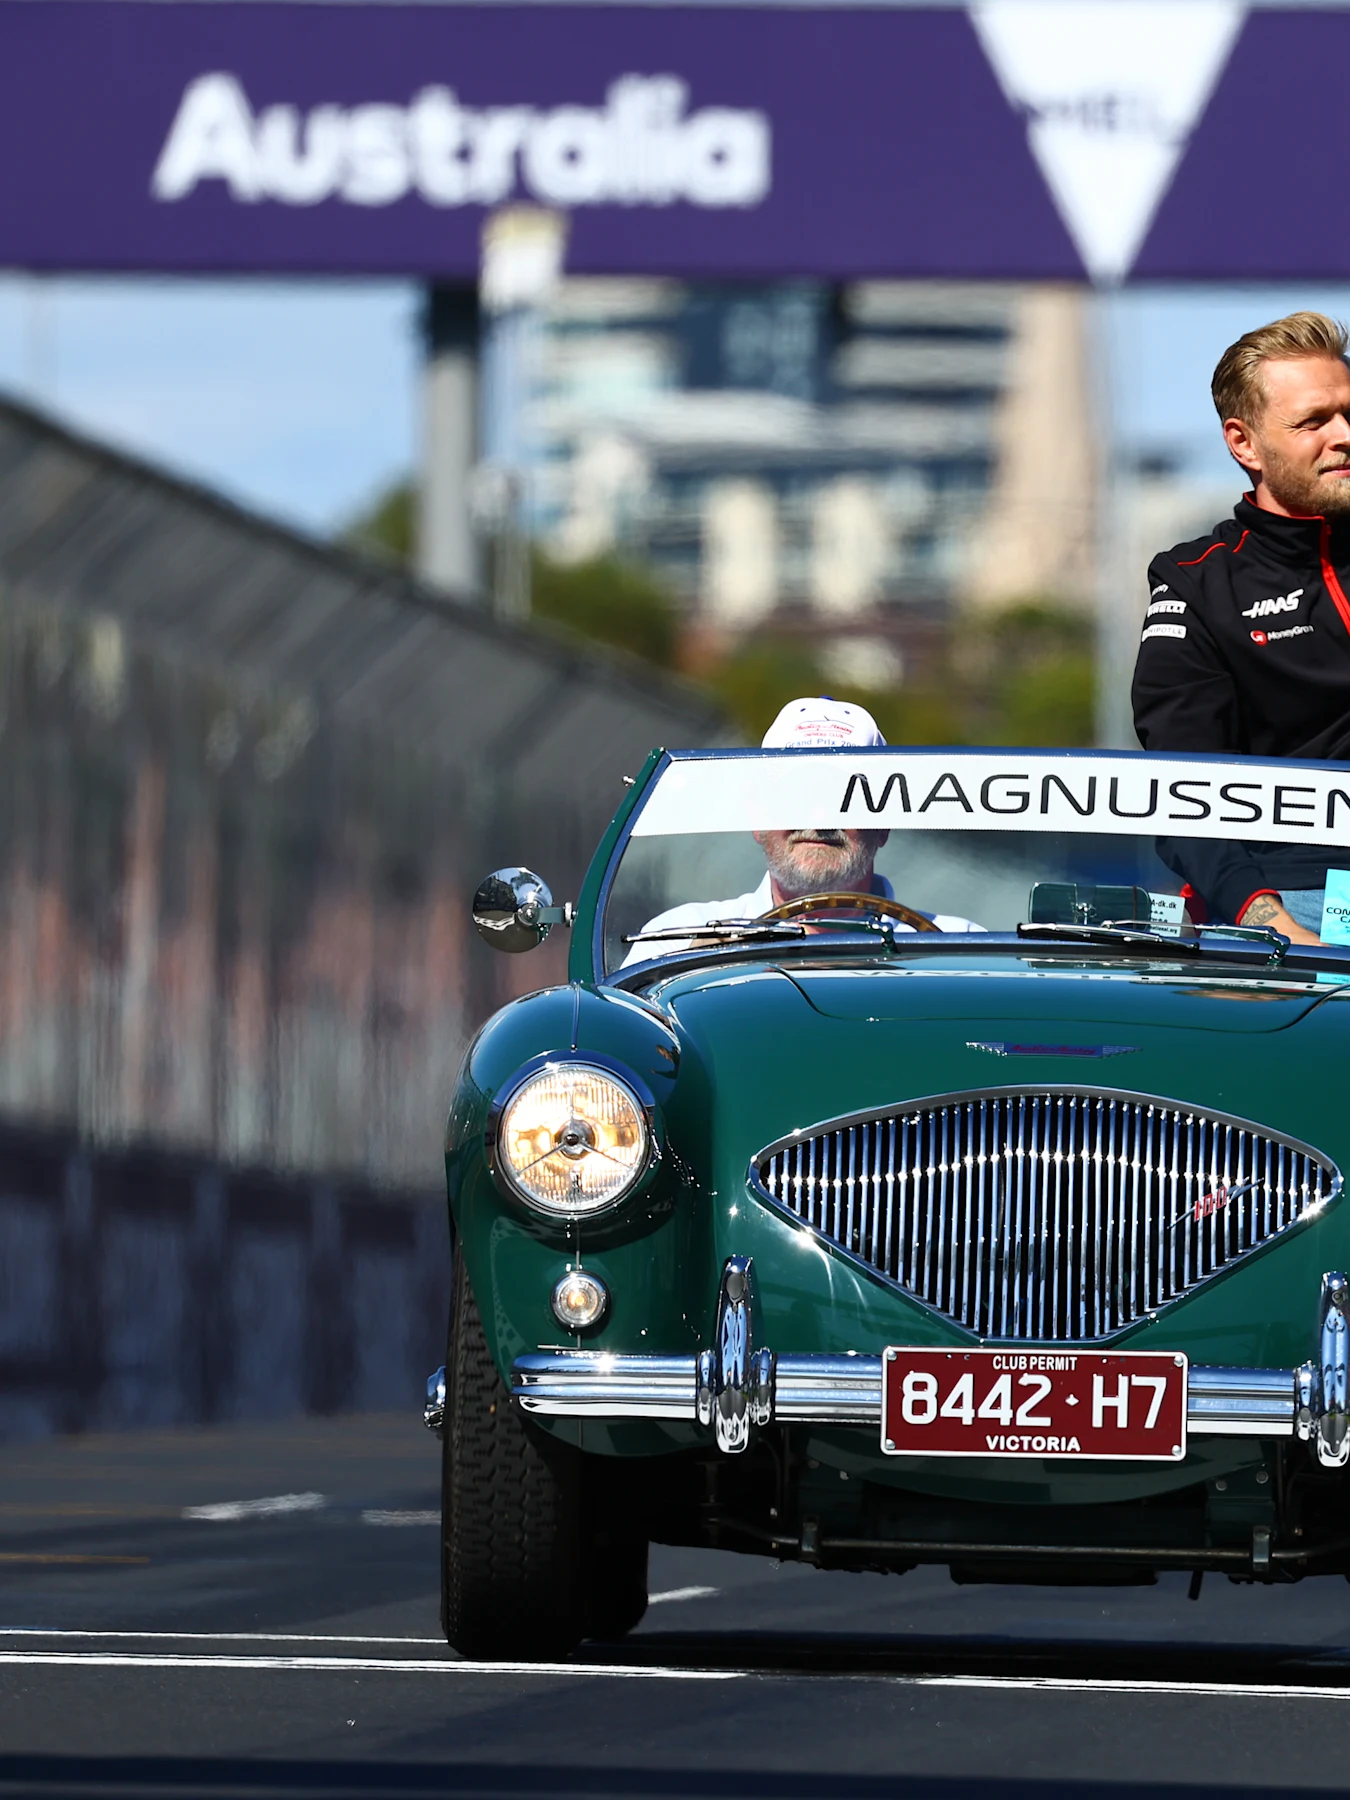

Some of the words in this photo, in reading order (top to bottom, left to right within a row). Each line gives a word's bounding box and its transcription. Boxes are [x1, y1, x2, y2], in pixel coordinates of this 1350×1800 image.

[154, 73, 769, 207] Australia
[1242, 588, 1304, 618] HAAS
[1193, 1185, 1227, 1222] 100
[992, 1356, 1027, 1370] CLUB
[1029, 1357, 1078, 1371] PERMIT
[901, 1371, 1053, 1427] 8442
[1091, 1373, 1167, 1429] H7
[985, 1435, 1081, 1452] VICTORIA
